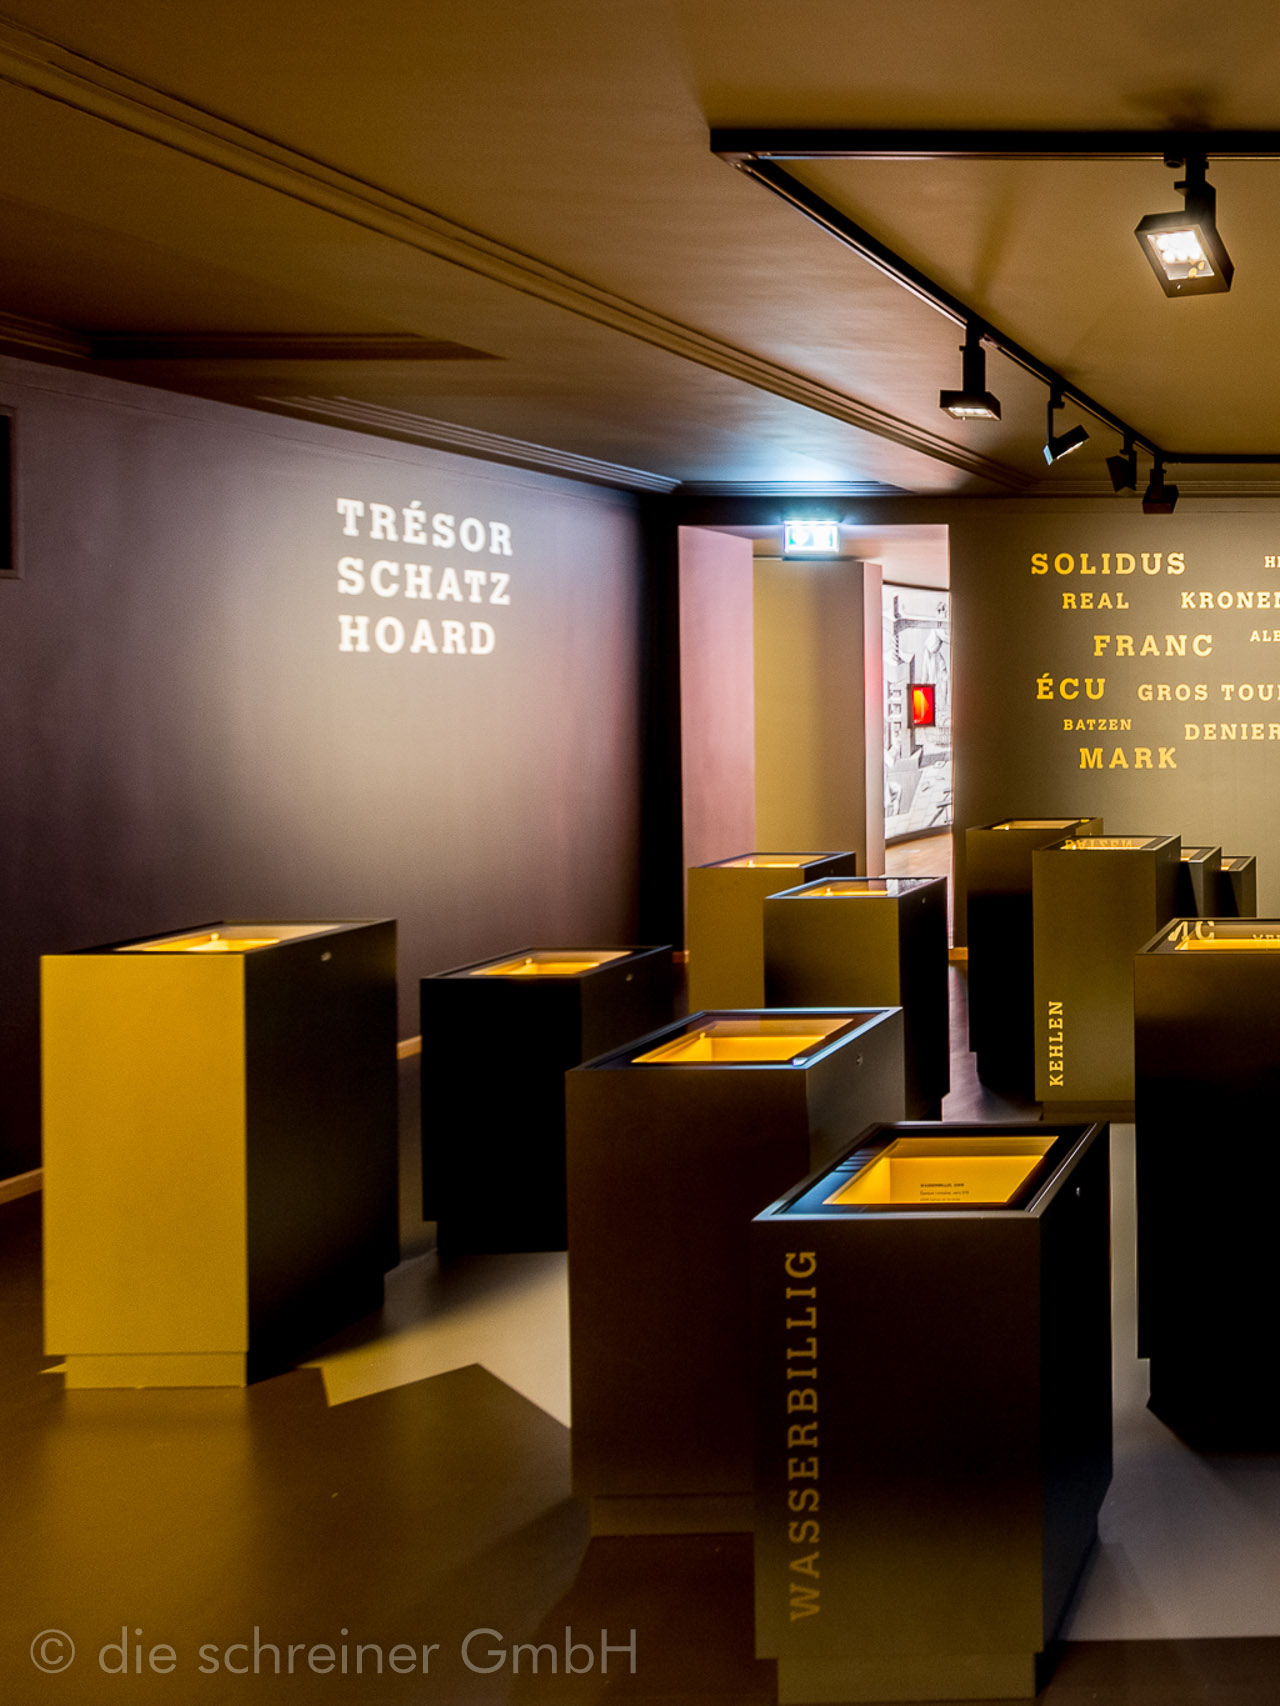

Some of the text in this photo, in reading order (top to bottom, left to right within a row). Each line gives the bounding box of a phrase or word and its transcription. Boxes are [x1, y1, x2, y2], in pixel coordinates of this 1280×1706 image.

[337, 498, 513, 556] TRÉSOR
[1030, 552, 1187, 576] SOLIDUS
[337, 557, 511, 605] SCHATZ
[1062, 592, 1130, 610] REAL
[338, 614, 496, 655] HOARD
[1092, 634, 1214, 657] FRANC
[1035, 673, 1107, 700] ÉCU
[1138, 683, 1208, 702] GROS
[1062, 718, 1133, 731] BATZEN
[1078, 746, 1178, 770] MARK
[1048, 1001, 1064, 1087] KEHLEN
[784, 1250, 821, 1622] WASSERBILLIG
